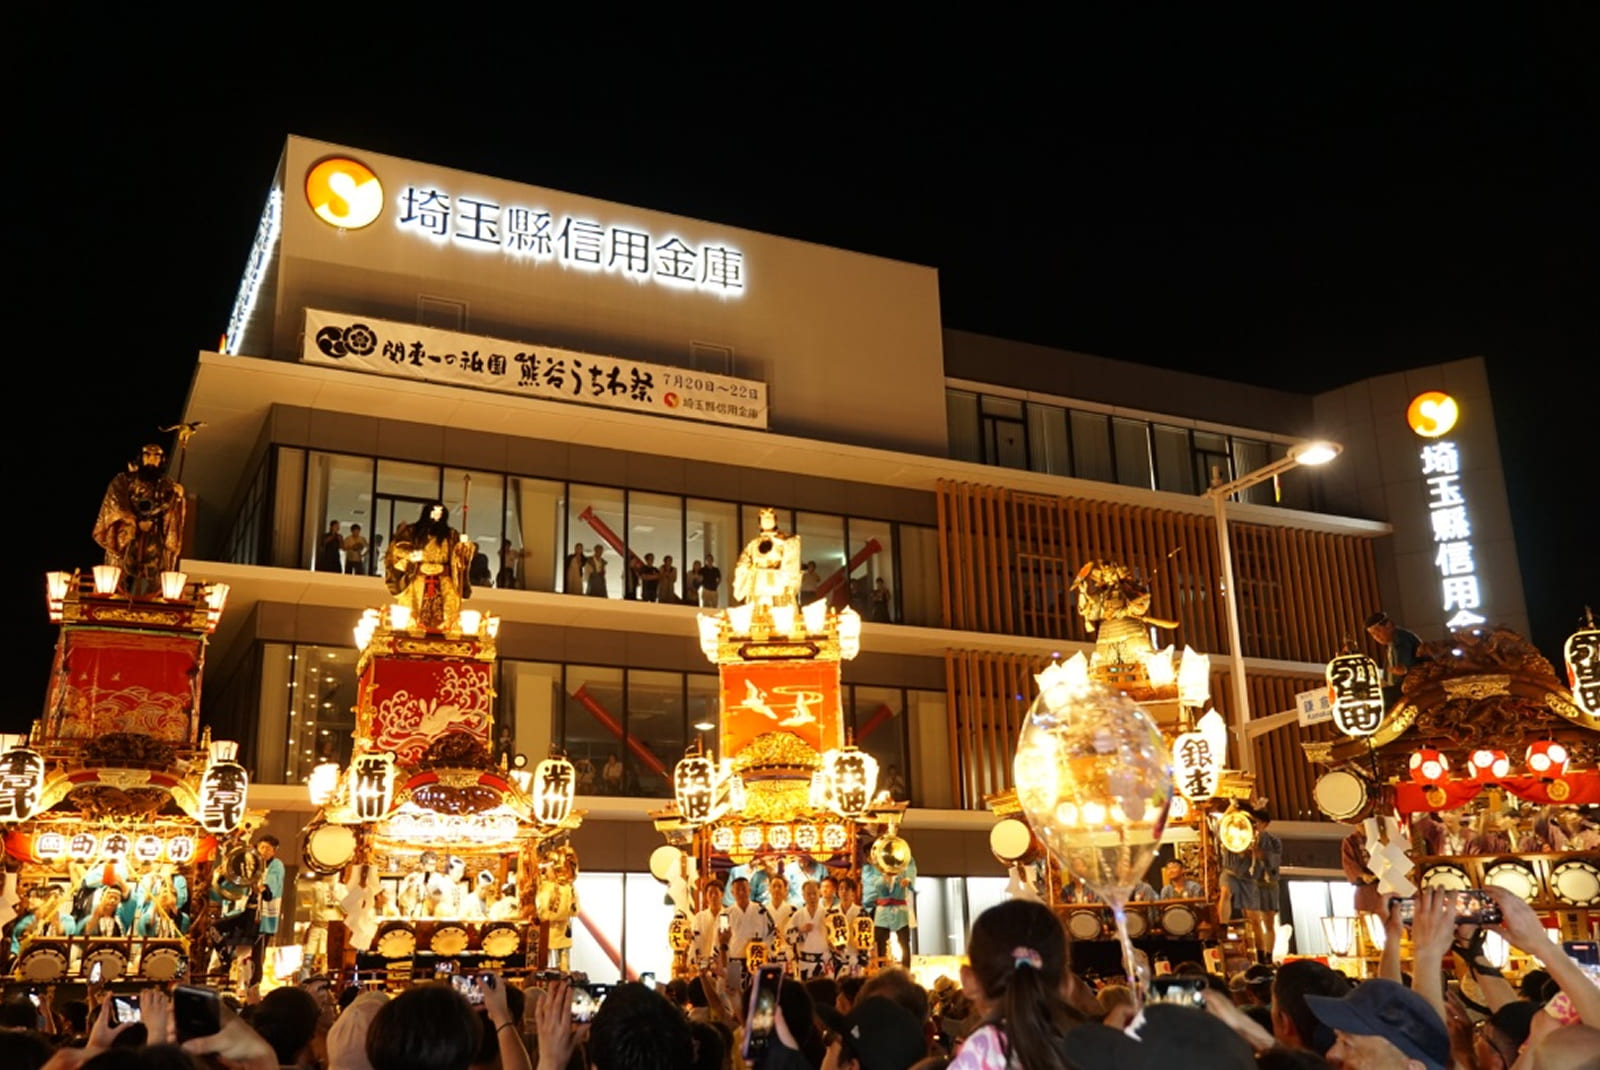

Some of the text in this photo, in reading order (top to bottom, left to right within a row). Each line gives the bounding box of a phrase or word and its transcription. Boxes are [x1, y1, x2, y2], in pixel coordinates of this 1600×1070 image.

[401, 185, 744, 289] 埼玉縣信用金庫
[514, 353, 654, 402] 熊谷うちわ祭
